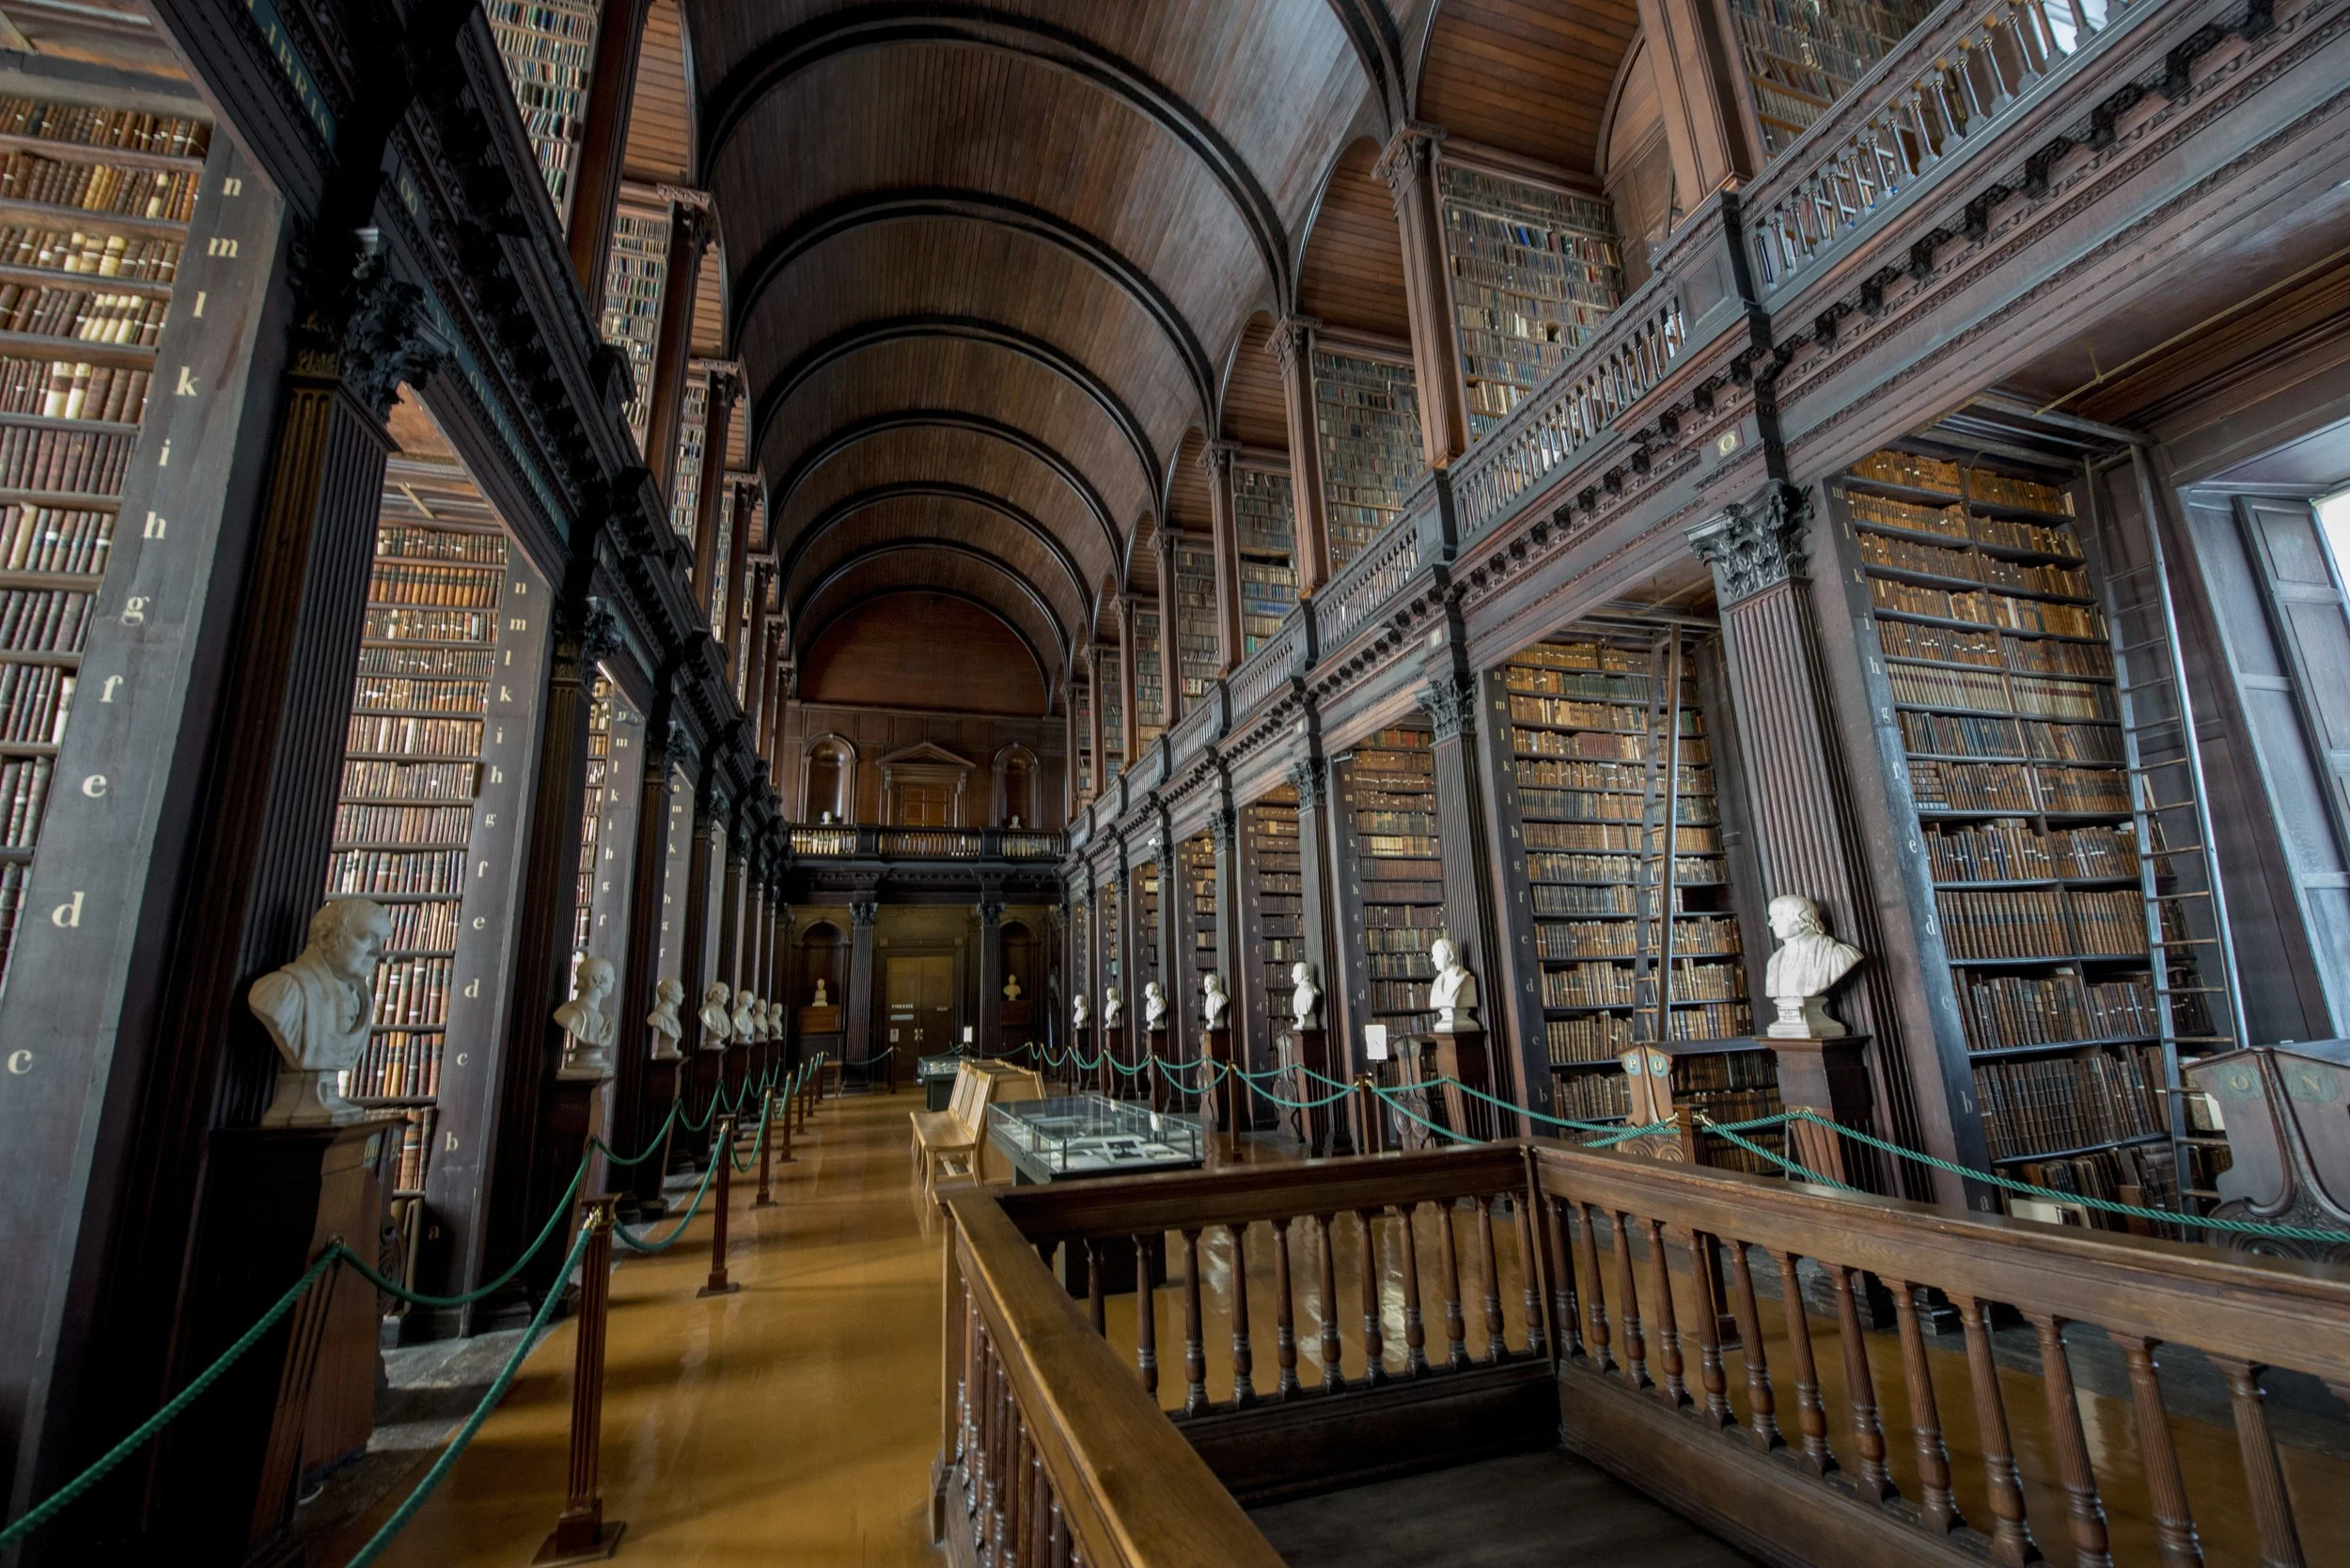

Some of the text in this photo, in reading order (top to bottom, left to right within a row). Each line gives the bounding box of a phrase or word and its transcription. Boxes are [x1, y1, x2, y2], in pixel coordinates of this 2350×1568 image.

[222, 178, 243, 196] n
[208, 238, 238, 258] m
[176, 366, 198, 396] k
[1720, 434, 1735, 451] O
[159, 438, 171, 467] i
[1832, 486, 1844, 498] m
[143, 511, 166, 539] h
[1843, 522, 1850, 539] l
[1853, 568, 1862, 583] k
[514, 582, 526, 594] n
[120, 596, 150, 624] g
[509, 619, 526, 630] m
[1863, 613, 1870, 630] i
[1869, 656, 1880, 674] h
[1494, 671, 1501, 680] n
[100, 675, 124, 703] f
[499, 686, 512, 702] k
[1496, 700, 1505, 710] m
[1881, 706, 1891, 722] g
[495, 726, 503, 743] i
[1501, 728, 1504, 740] l
[616, 738, 628, 746] m
[1503, 761, 1510, 771] k
[1893, 760, 1901, 779] f
[490, 765, 502, 784] h
[82, 774, 107, 798] e
[610, 789, 618, 801] k
[1507, 793, 1511, 804] i
[485, 812, 496, 827] g
[607, 817, 613, 830] i
[1511, 826, 1519, 838] h
[605, 847, 613, 860] h
[1908, 840, 1917, 853] e
[478, 860, 488, 878] f
[1514, 860, 1520, 871] g
[602, 881, 610, 892] g
[1518, 891, 1524, 903] f
[52, 891, 84, 927] d
[472, 917, 486, 929] e
[598, 914, 606, 925] f
[1925, 914, 1936, 935] d
[1521, 936, 1528, 944] e
[463, 979, 479, 997] d
[1526, 978, 1534, 992] d
[1533, 1036, 1538, 1045] c
[7, 1049, 32, 1074] c
[456, 1053, 468, 1066] c
[1629, 1058, 1637, 1069] P
[1653, 1060, 1663, 1071] O
[2230, 1074, 2249, 1091] O
[1538, 1087, 1548, 1102] b
[1962, 1090, 1973, 1112] b
[445, 1131, 458, 1151] b
[1980, 1196, 1990, 1211] a
[428, 1225, 439, 1239] a
